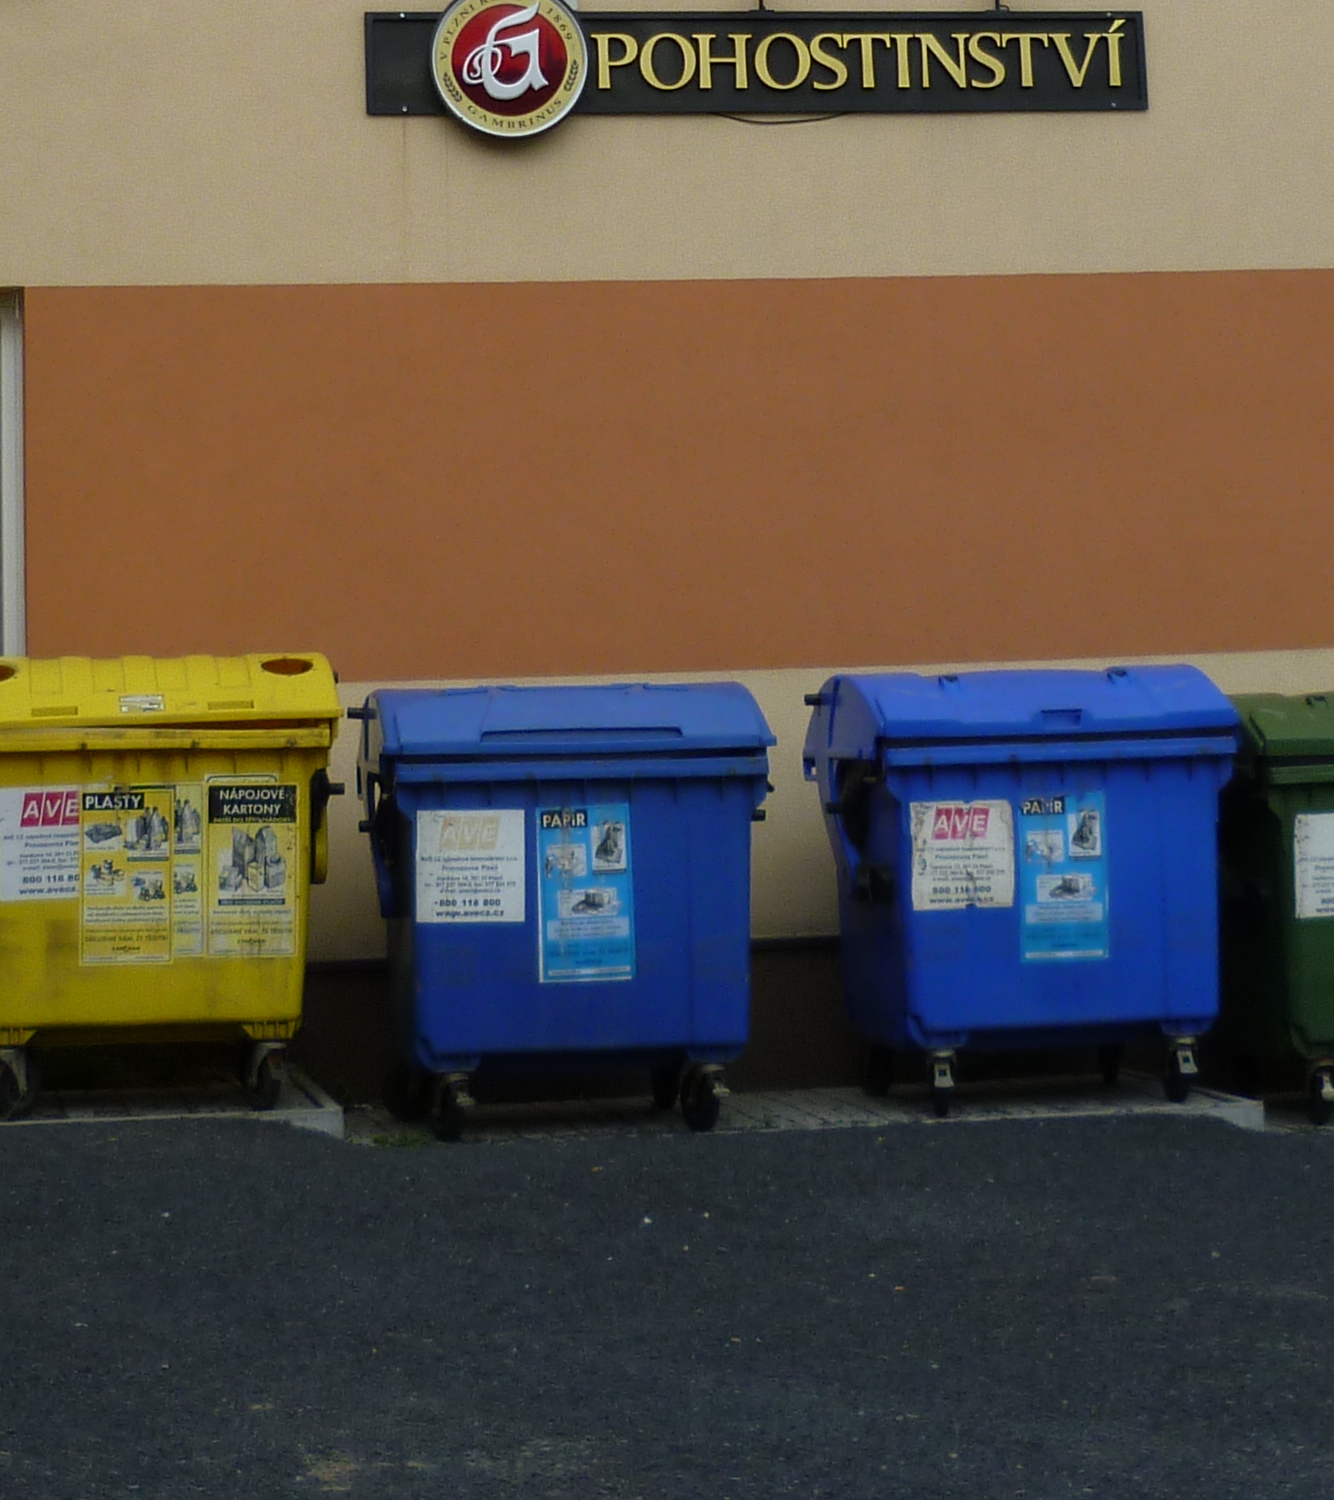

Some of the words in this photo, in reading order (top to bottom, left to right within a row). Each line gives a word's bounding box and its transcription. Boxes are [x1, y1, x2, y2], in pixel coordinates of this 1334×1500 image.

[444, 4, 475, 46] PLZNI
[545, 7, 573, 40] 1869
[590, 18, 1126, 92] POHOSTINSTVÍ
[467, 99, 563, 129] GAMBRINUS
[22, 798, 79, 819] AVE
[85, 794, 142, 809] PLASTY
[223, 803, 281, 815] KARTONY
[934, 814, 987, 832] AVE
[22, 875, 43, 884] 800
[46, 874, 65, 883] 118
[461, 898, 479, 907] 118
[483, 898, 501, 907] 800
